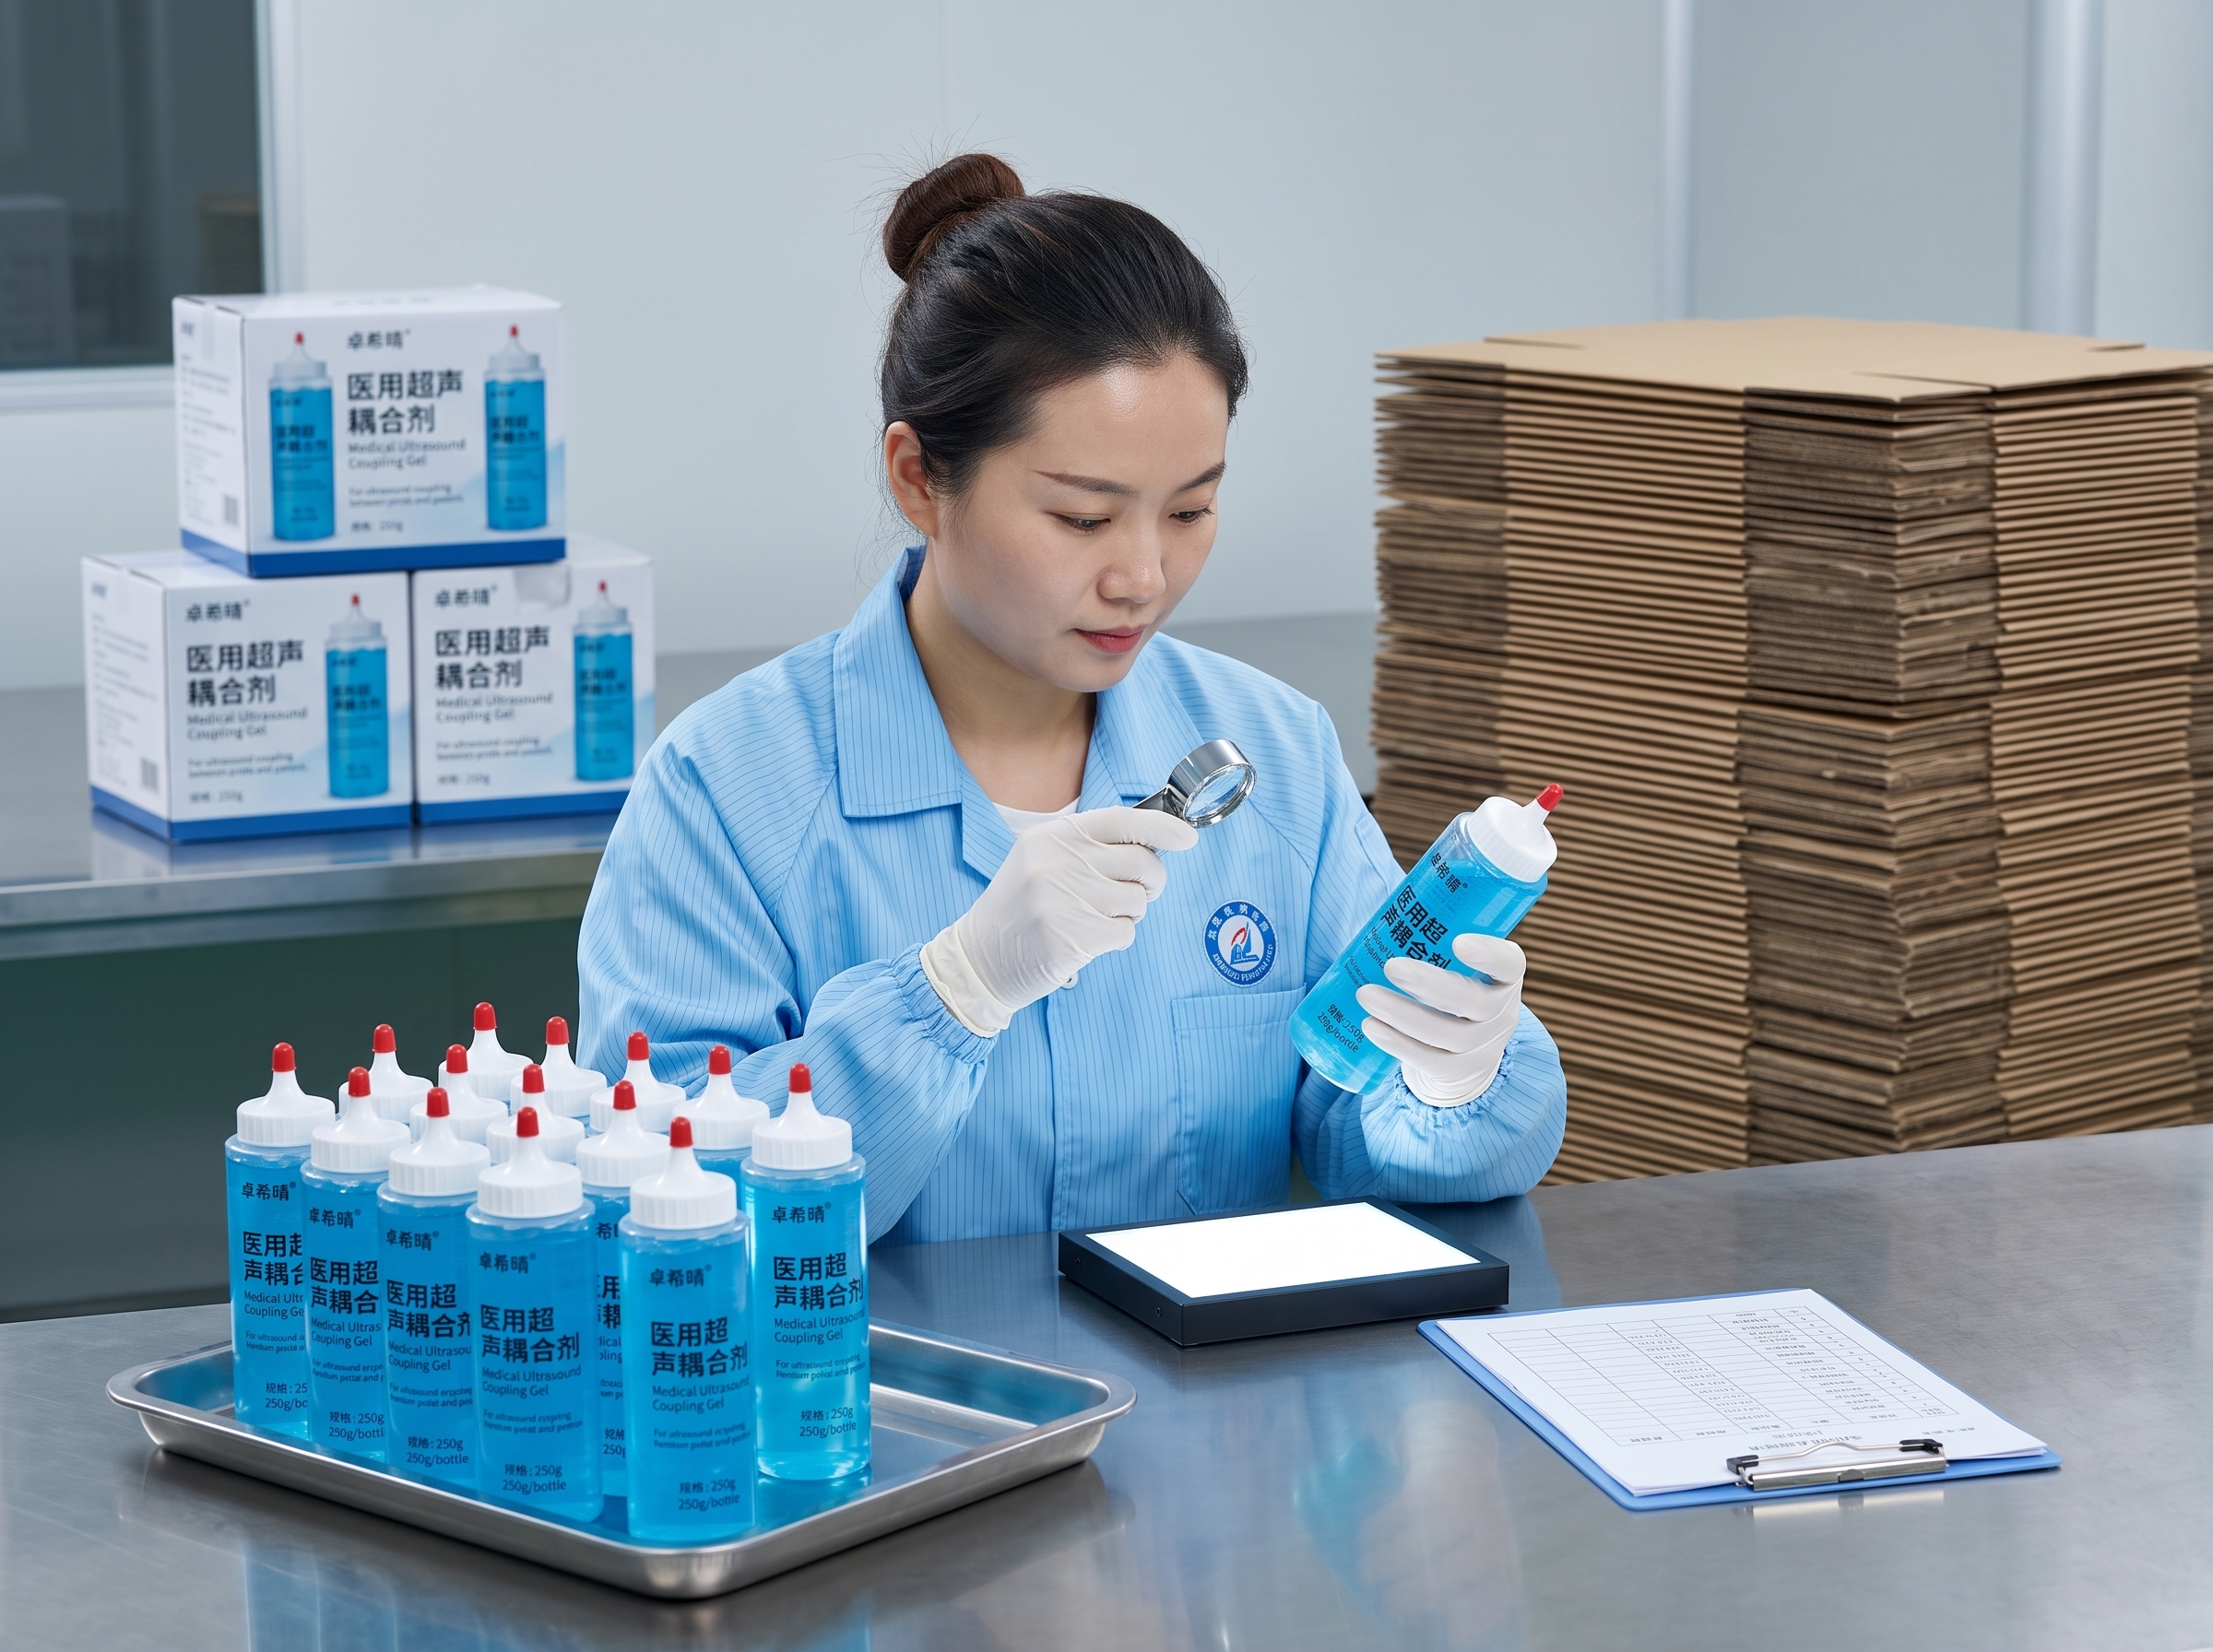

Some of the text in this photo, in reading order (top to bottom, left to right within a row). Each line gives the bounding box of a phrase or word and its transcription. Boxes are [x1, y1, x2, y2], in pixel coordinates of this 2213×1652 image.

[348, 369, 463, 400] 医用超声
[349, 405, 434, 434] 耦合剂
[349, 442, 396, 453] Medical
[349, 457, 403, 470] Coupling
[435, 626, 550, 657] 医用超声
[187, 640, 302, 672] 医用超声
[435, 659, 522, 689] 耦合剂
[187, 675, 275, 706] 耦合剂
[310, 1257, 379, 1286] 医用超
[774, 1252, 847, 1281] 医用超
[244, 1291, 280, 1304] Medical
[311, 1285, 379, 1316] 声耦合
[386, 1279, 456, 1309] 医用超
[775, 1274, 864, 1311] 声耦合剂
[244, 1304, 288, 1320] Coupling
[480, 1304, 555, 1333] 医用超
[312, 1316, 345, 1332] Medical
[651, 1316, 728, 1347] 医用超
[775, 1317, 817, 1329] Medical
[354, 1335, 373, 1347] Gel
[775, 1328, 844, 1346] Coupling Gel
[388, 1340, 471, 1357] Medical Ultrasou
[481, 1332, 580, 1363] 声耦合剂
[388, 1354, 430, 1374] Coupling
[432, 1360, 451, 1371] Gel
[652, 1340, 748, 1378] 声耦合剂
[482, 1366, 520, 1382] Medical
[529, 1385, 549, 1396] Gel
[653, 1386, 696, 1398] Medical
[653, 1397, 725, 1414] Coupling Gel
[799, 1421, 857, 1438] 250g/bottle
[407, 1452, 468, 1468] 250g/bottle
[503, 1480, 567, 1494] 250g/bottle
[678, 1493, 740, 1512] 250g/bottle
